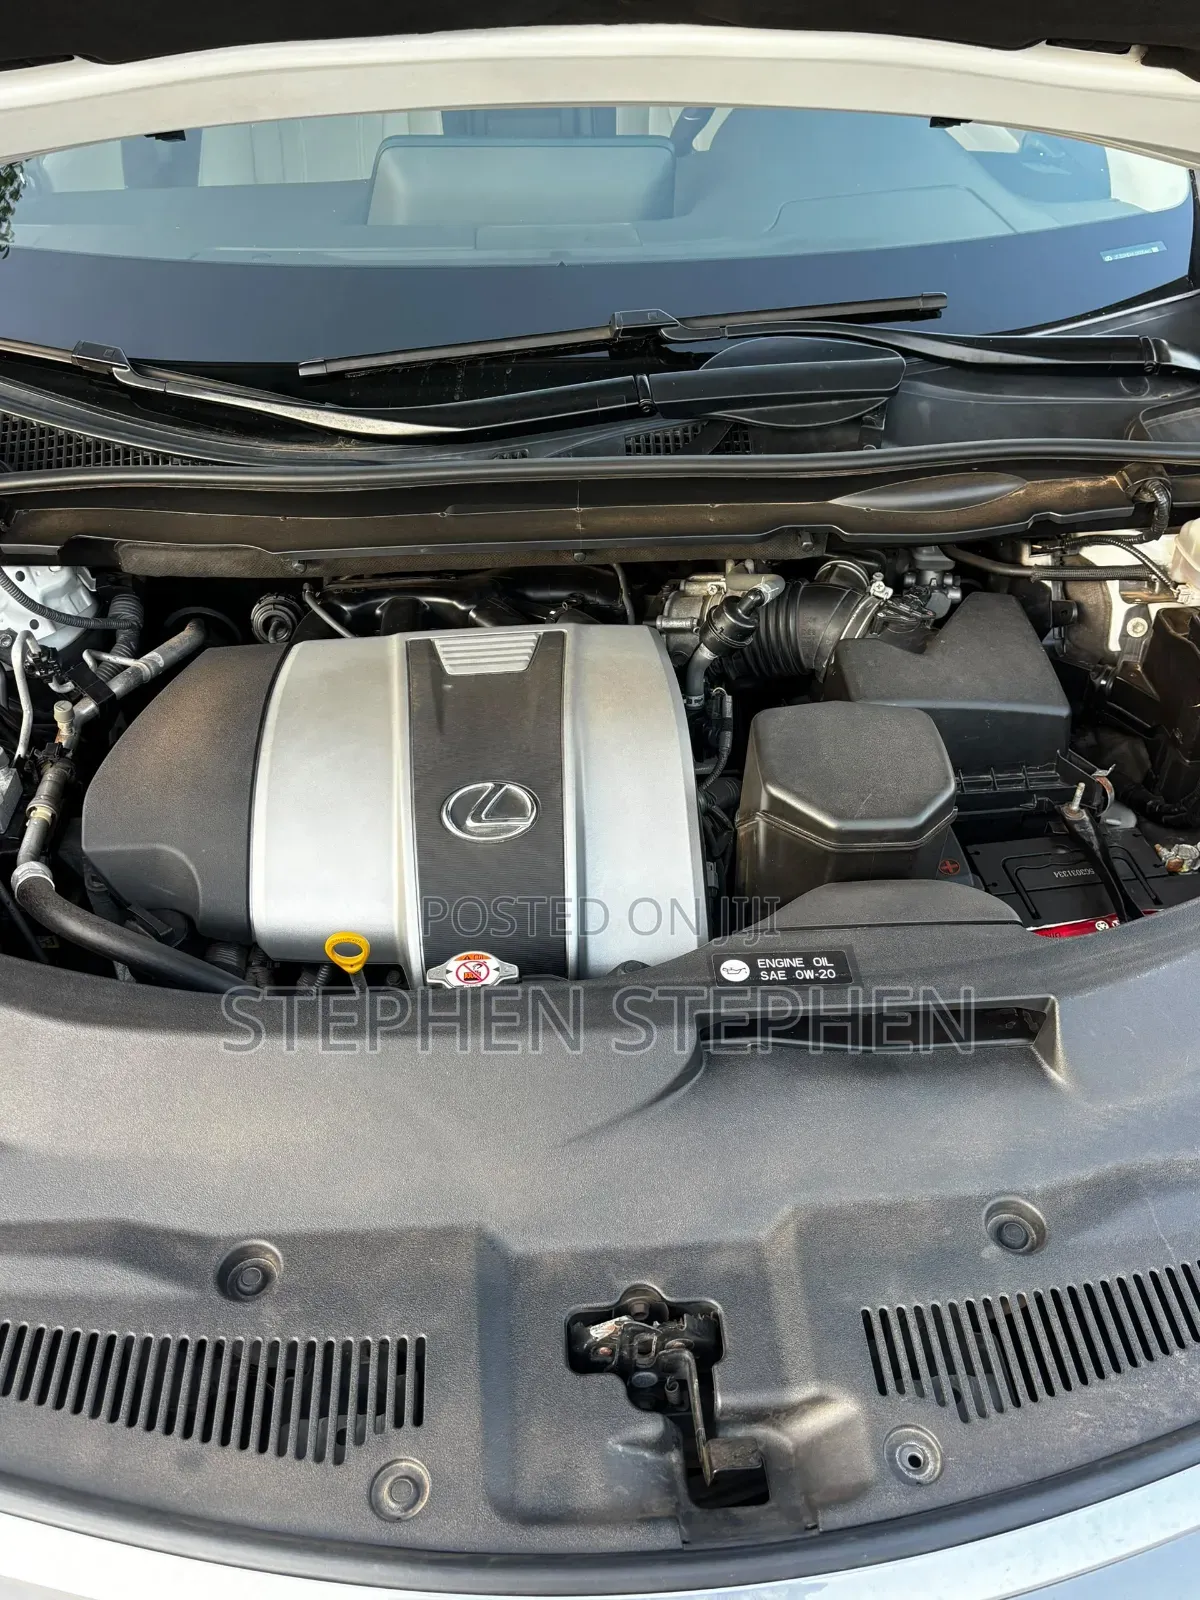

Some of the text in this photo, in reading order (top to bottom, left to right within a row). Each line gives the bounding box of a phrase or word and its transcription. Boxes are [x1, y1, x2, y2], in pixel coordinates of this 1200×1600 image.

[757, 957, 834, 968] ENGINE OIL
[760, 969, 836, 980] SAE 0W-20
